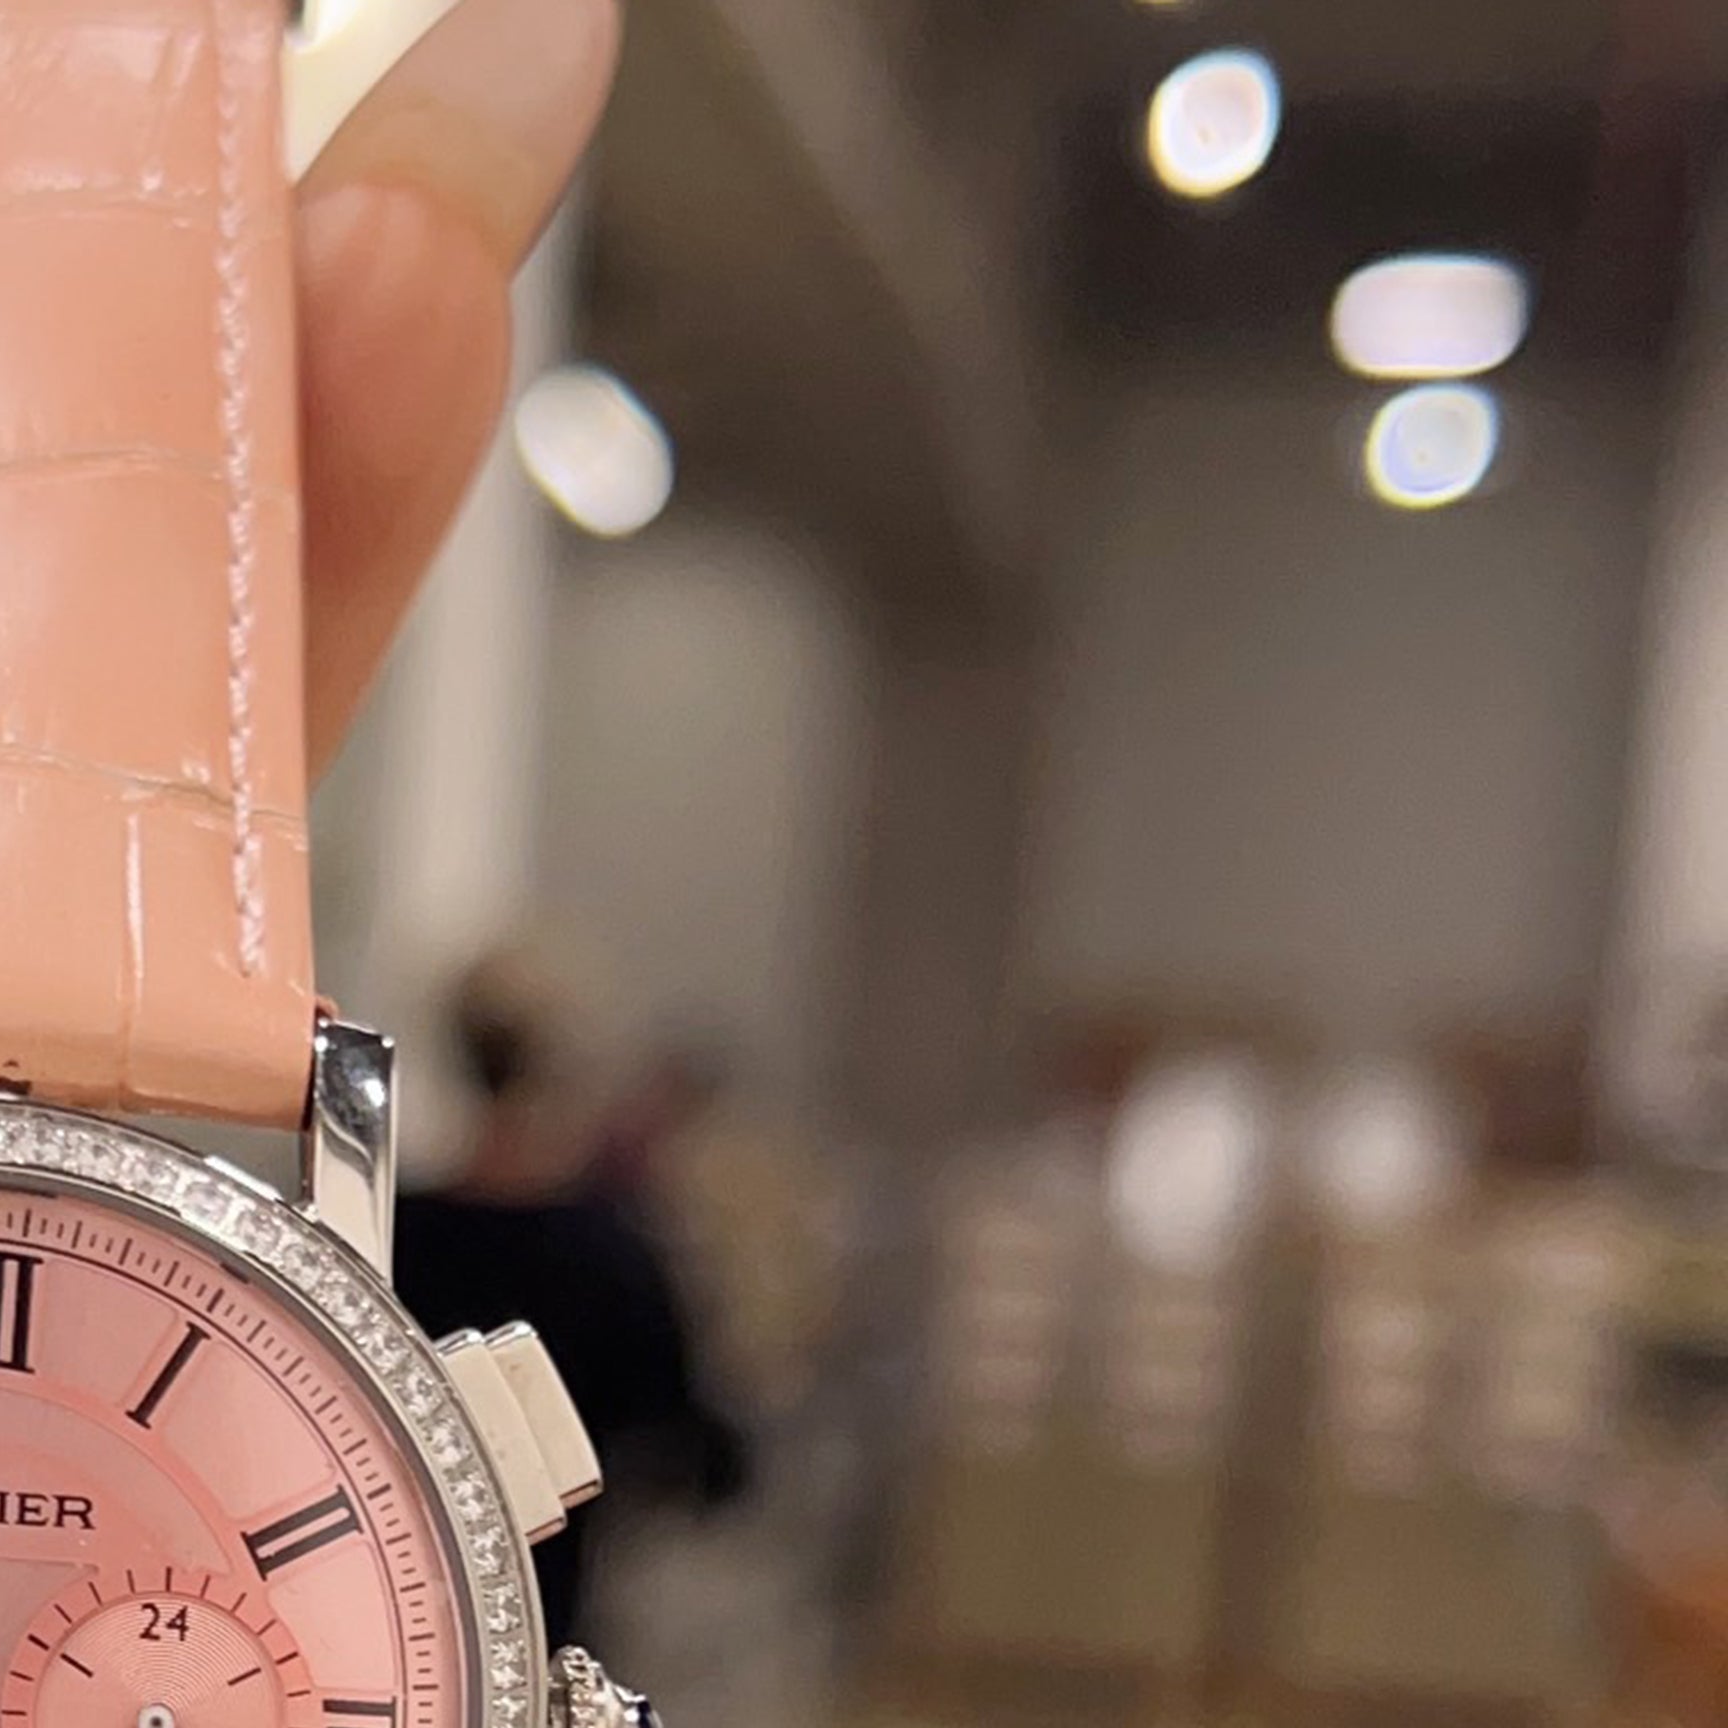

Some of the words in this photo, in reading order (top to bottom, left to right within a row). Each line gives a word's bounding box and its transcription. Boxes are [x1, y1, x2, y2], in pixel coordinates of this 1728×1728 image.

[125, 1321, 211, 1429] I
[240, 1483, 364, 1581] II
[139, 1603, 189, 1641] 24
